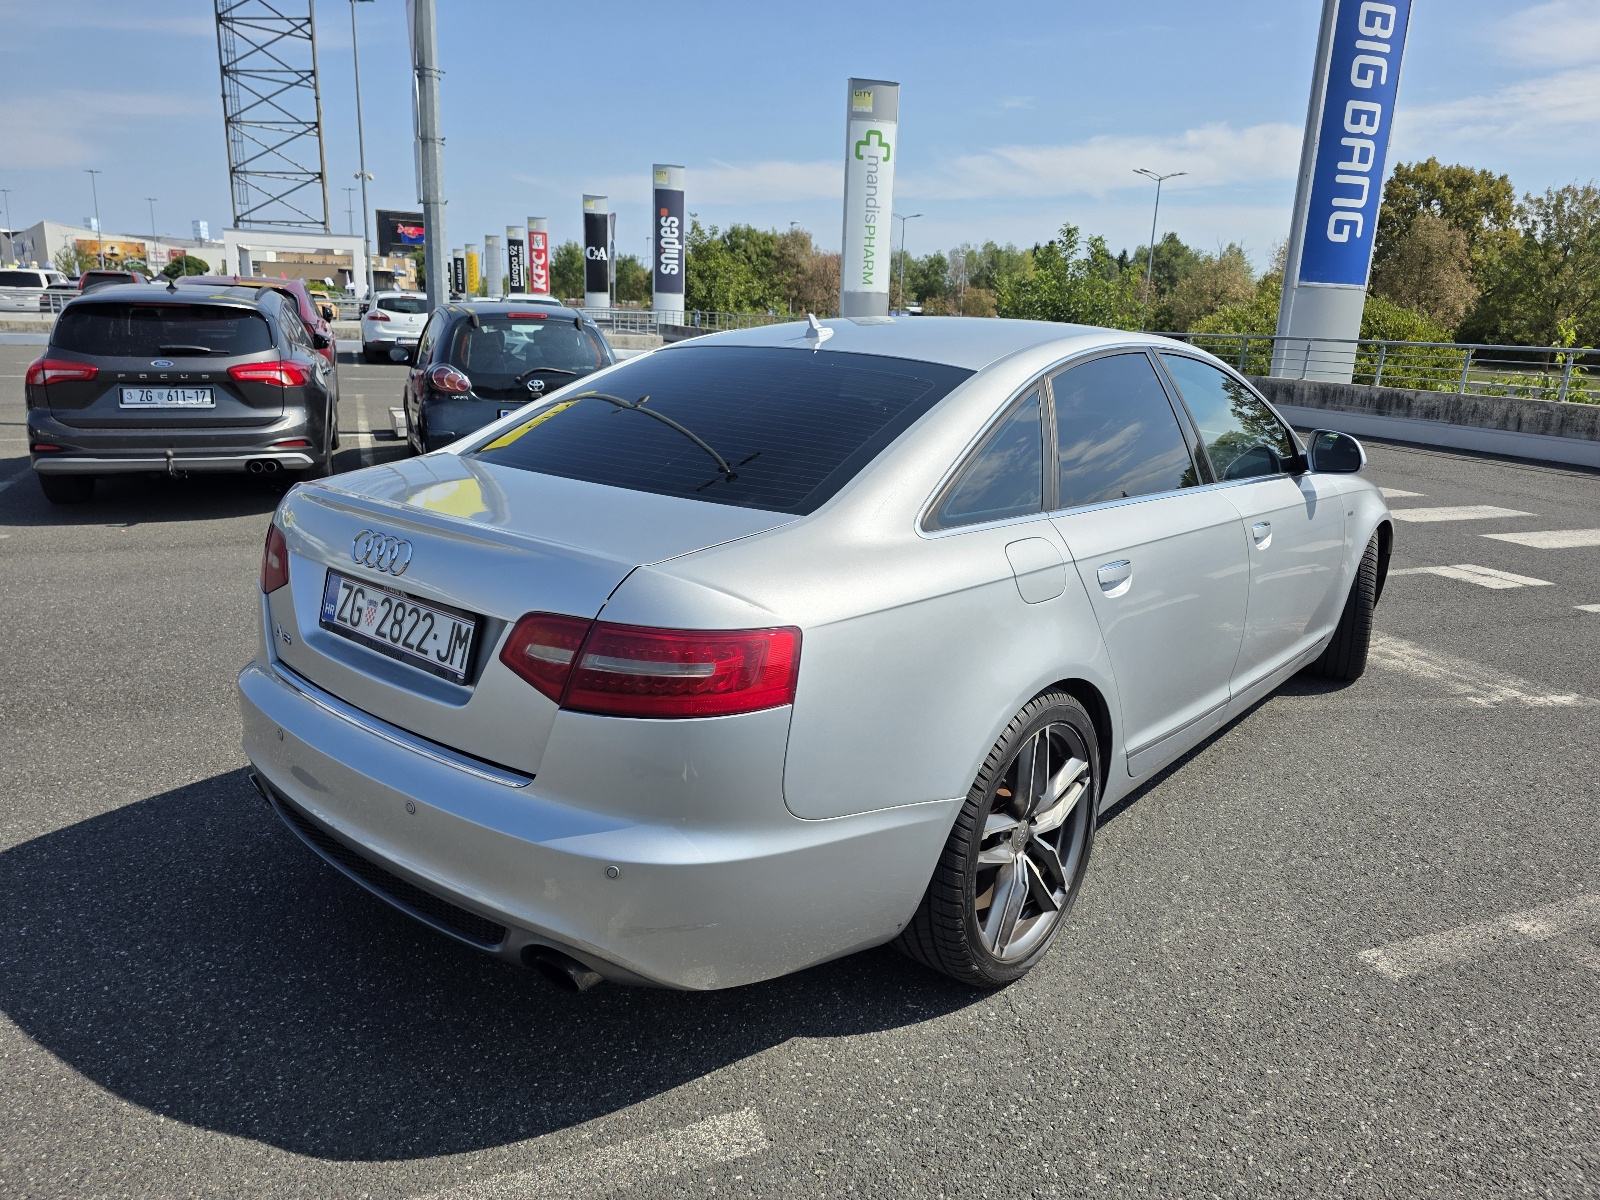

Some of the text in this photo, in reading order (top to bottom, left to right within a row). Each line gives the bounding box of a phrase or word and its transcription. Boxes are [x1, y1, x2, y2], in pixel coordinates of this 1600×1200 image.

[854, 89, 872, 97] CITY
[1326, 1, 1397, 243] BIG BANG
[509, 245, 518, 256] 92
[586, 246, 608, 261] C&A
[660, 216, 683, 275] snipes
[510, 257, 521, 287] Europa
[531, 252, 547, 291] KFC
[139, 390, 153, 402] ZG
[166, 390, 206, 402] 611-17
[324, 602, 336, 616] HR
[336, 582, 366, 628] ZG
